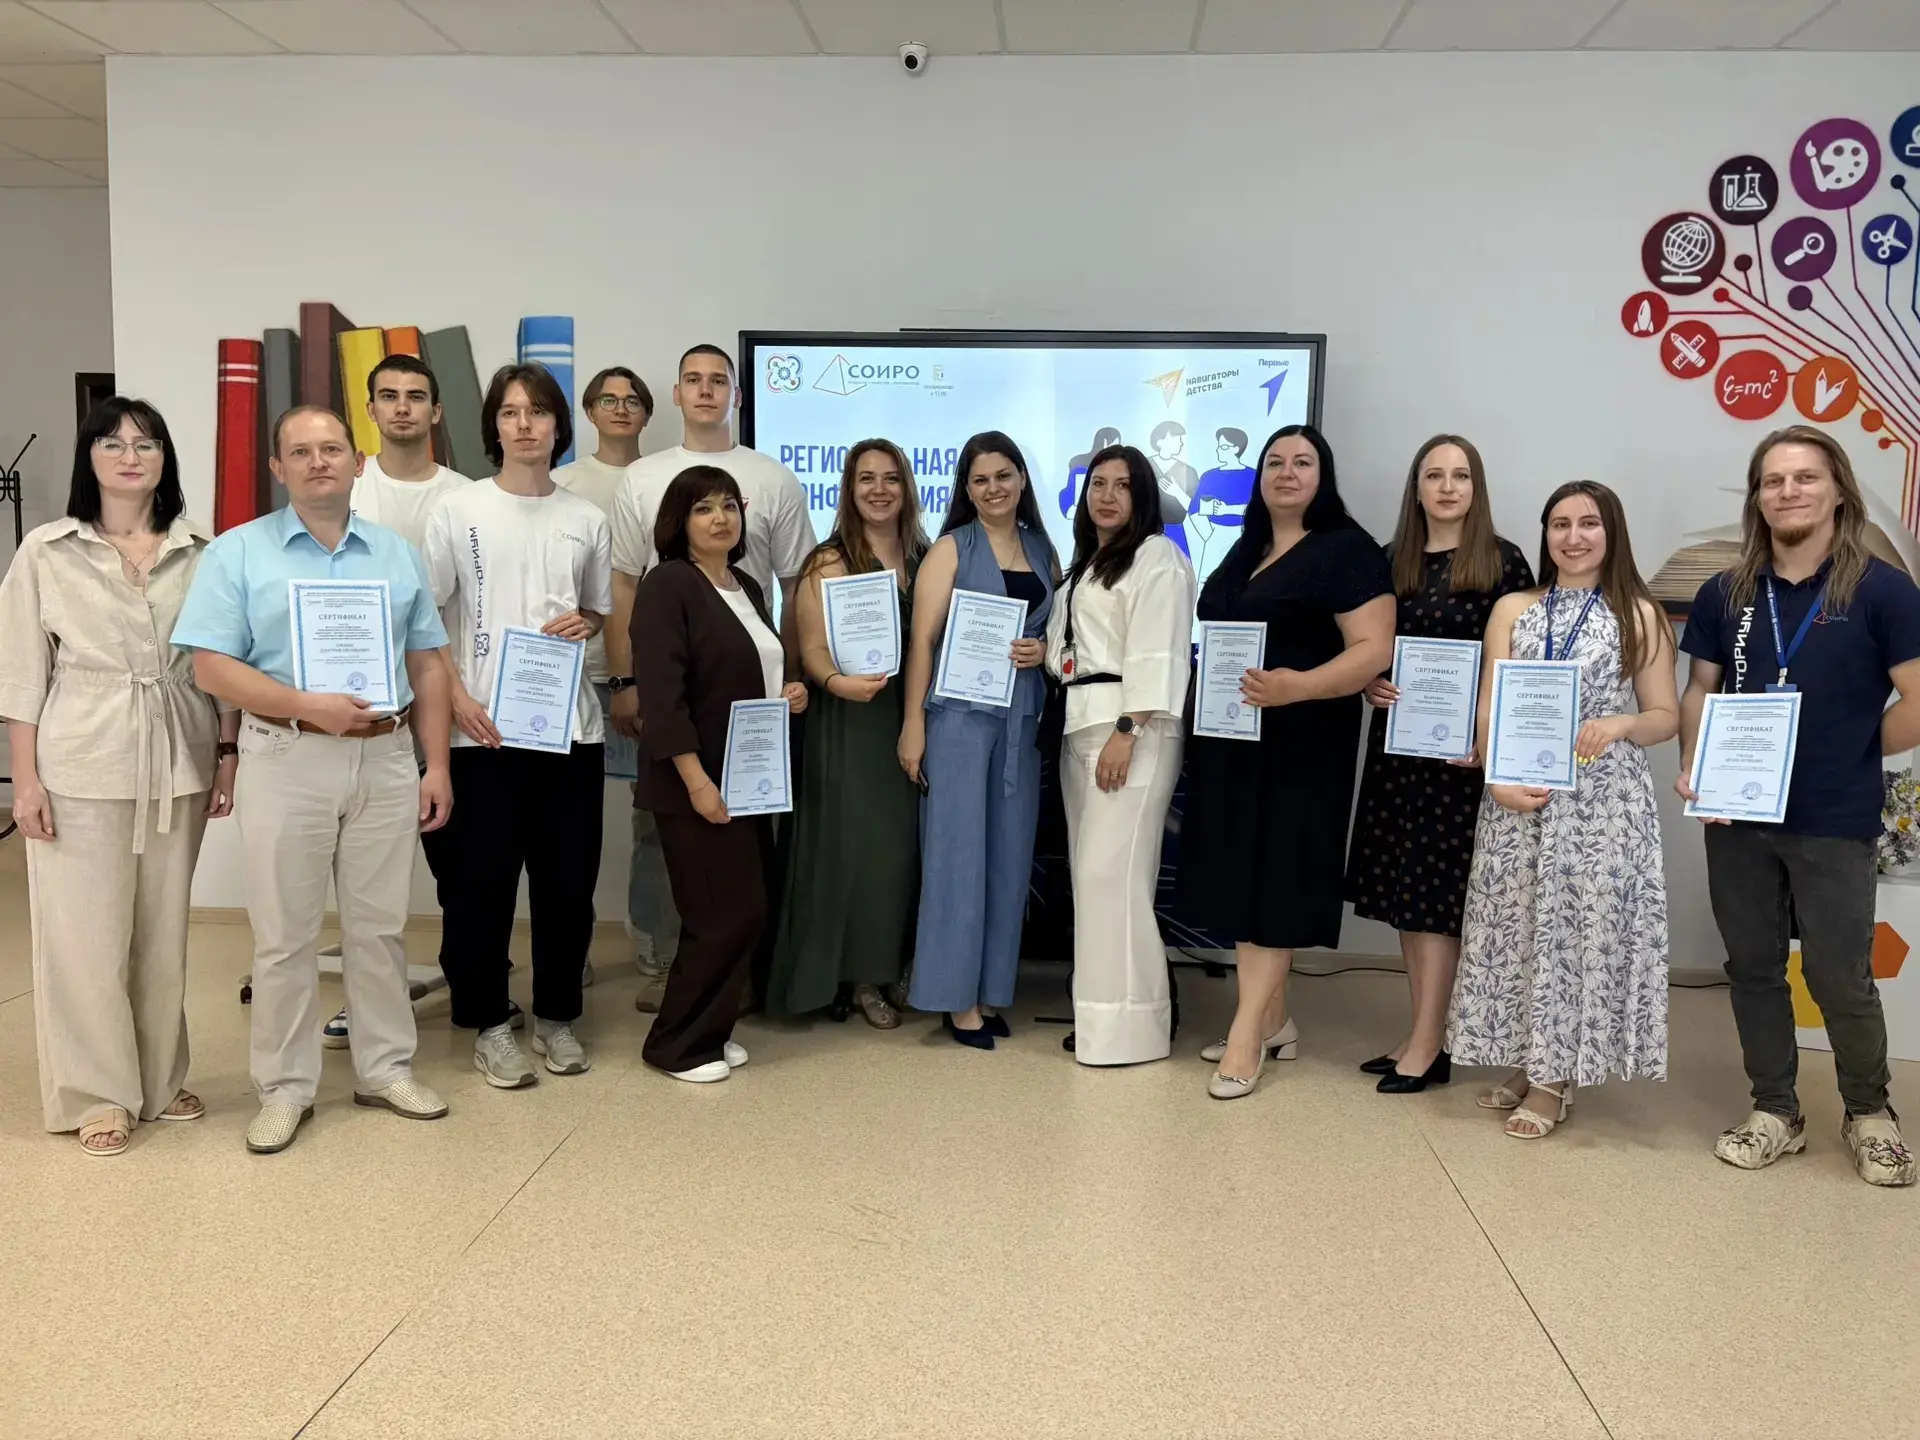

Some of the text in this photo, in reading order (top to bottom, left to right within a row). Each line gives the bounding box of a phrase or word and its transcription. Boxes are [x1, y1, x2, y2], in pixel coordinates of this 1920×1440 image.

[1258, 358, 1289, 368] Первые
[848, 364, 920, 379] СОИРО
[1186, 369, 1239, 386] НАВИГАТОРЫ
[1186, 381, 1222, 396] ДЕТСТВА
[1734, 607, 1755, 693] ТОРИУМ
[1414, 667, 1459, 675] СЕРТИФИКАТ
[1516, 692, 1560, 700] СЕРТИФИКАТ
